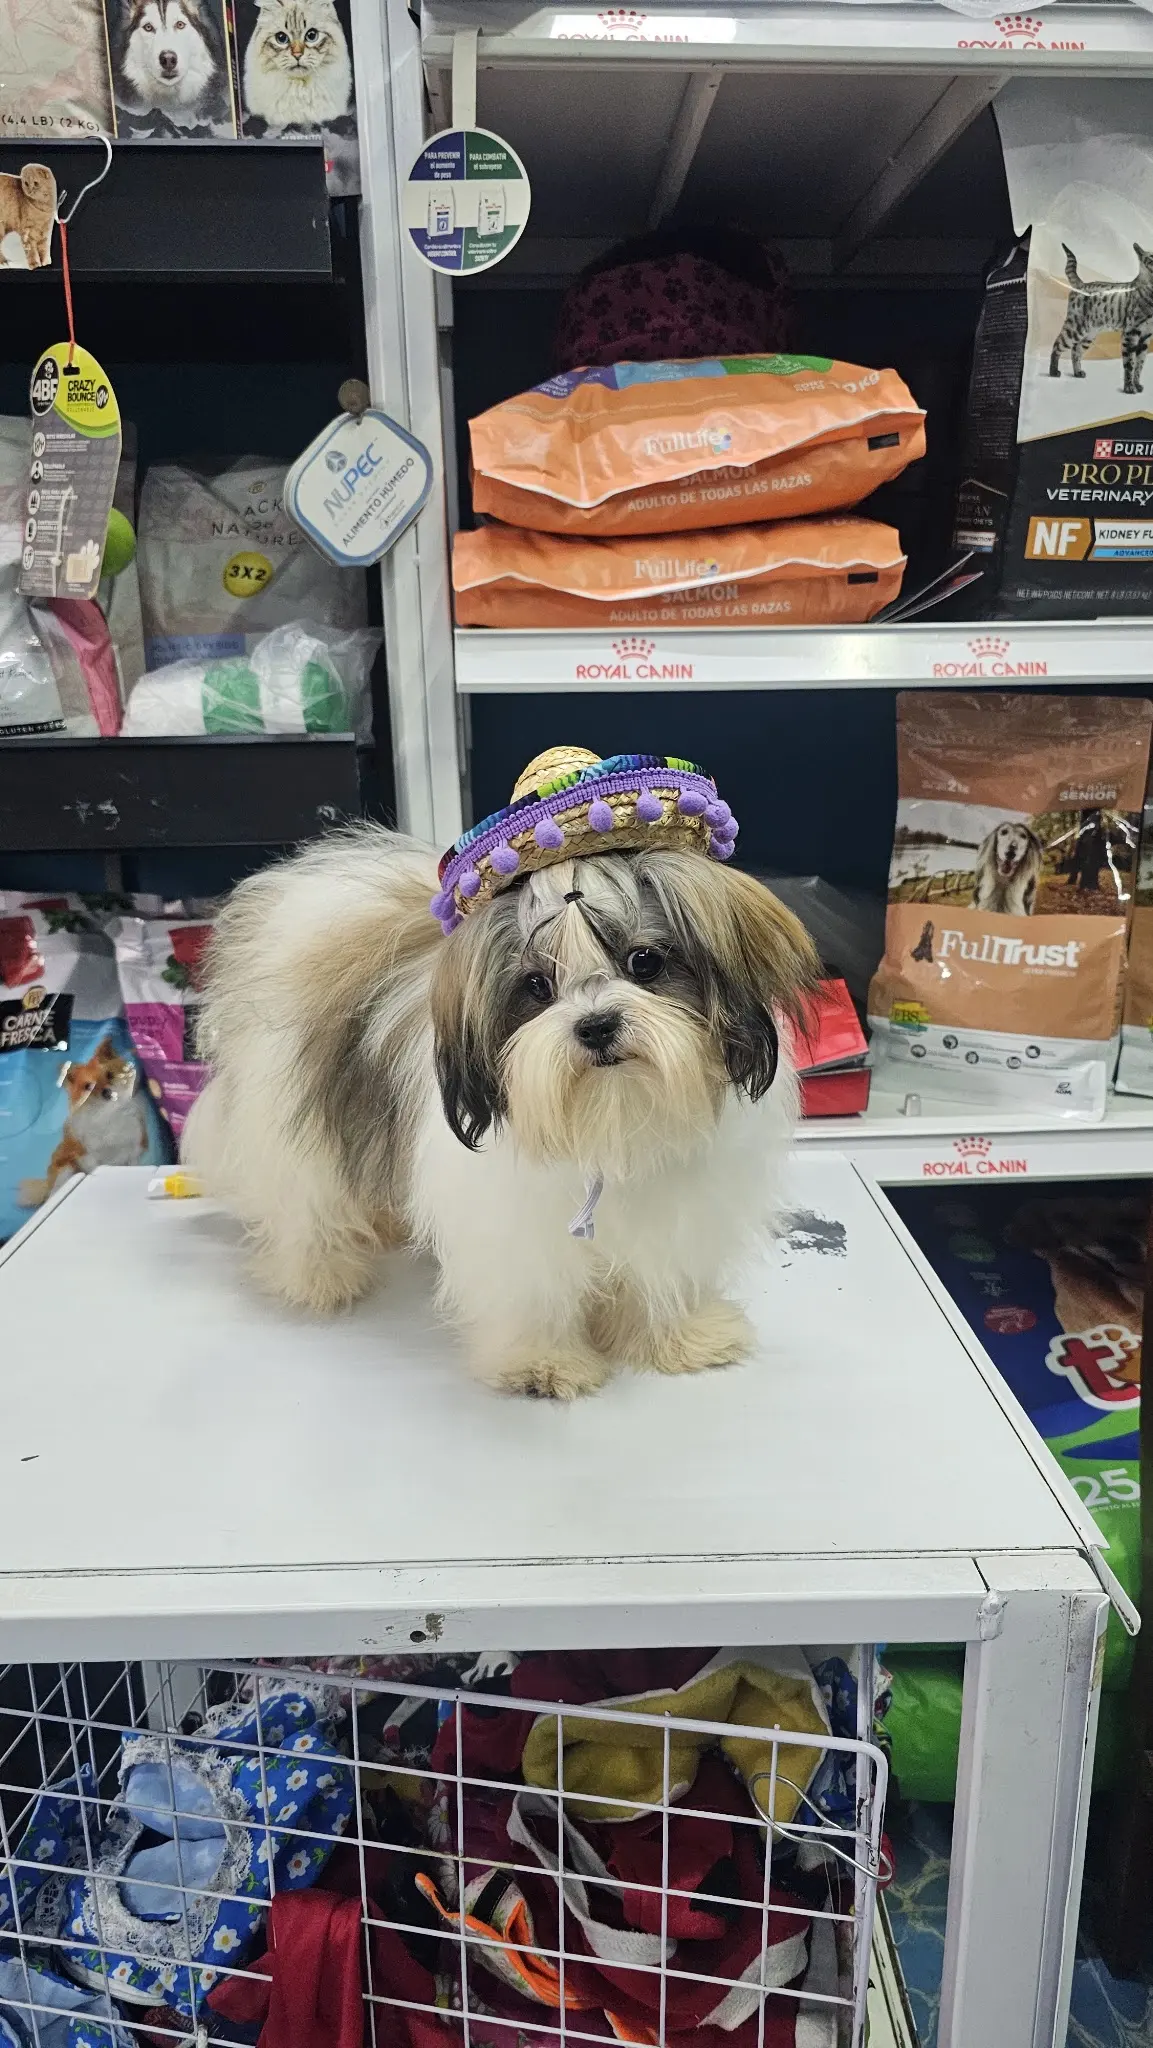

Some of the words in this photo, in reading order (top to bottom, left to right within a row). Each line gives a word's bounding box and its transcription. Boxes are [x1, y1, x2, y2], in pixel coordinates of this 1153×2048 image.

[32, 116, 54, 126] LB)
[60, 117, 73, 128] (2
[79, 119, 100, 132] KG)
[67, 380, 97, 392] CRAZY
[67, 392, 95, 402] BOUNCE
[643, 428, 723, 456] FullLife
[323, 442, 384, 521] NUPEC
[1060, 463, 1122, 485] PRO
[342, 497, 382, 548] ALIMENTO
[380, 457, 415, 499] HÚMEDO
[627, 493, 677, 512] ADULTO
[679, 492, 697, 505] DE
[700, 486, 742, 501] TODAS
[745, 480, 769, 494] LAS
[771, 474, 813, 491] RAZAS
[1032, 520, 1083, 557] NF
[1099, 529, 1141, 540] KIDNEY
[633, 558, 705, 582] FullLife
[609, 608, 658, 622] ADULTO
[661, 608, 677, 620] DE
[681, 604, 722, 618] TODAS
[725, 603, 748, 616] LAS
[751, 600, 792, 615] RAZAS
[576, 664, 632, 679] ROYAL
[636, 664, 693, 679] CANIN
[933, 663, 987, 677] ROYAL
[992, 662, 1048, 676] CANIN
[1059, 791, 1117, 802] SENIOR
[936, 929, 1080, 968] FullTrust
[3, 1009, 56, 1032] CARNE
[1, 1027, 57, 1048] FRESCA
[923, 1162, 972, 1176] ROYAL
[976, 1160, 1027, 1174] CANIN
[1069, 1467, 1141, 1508] 25
